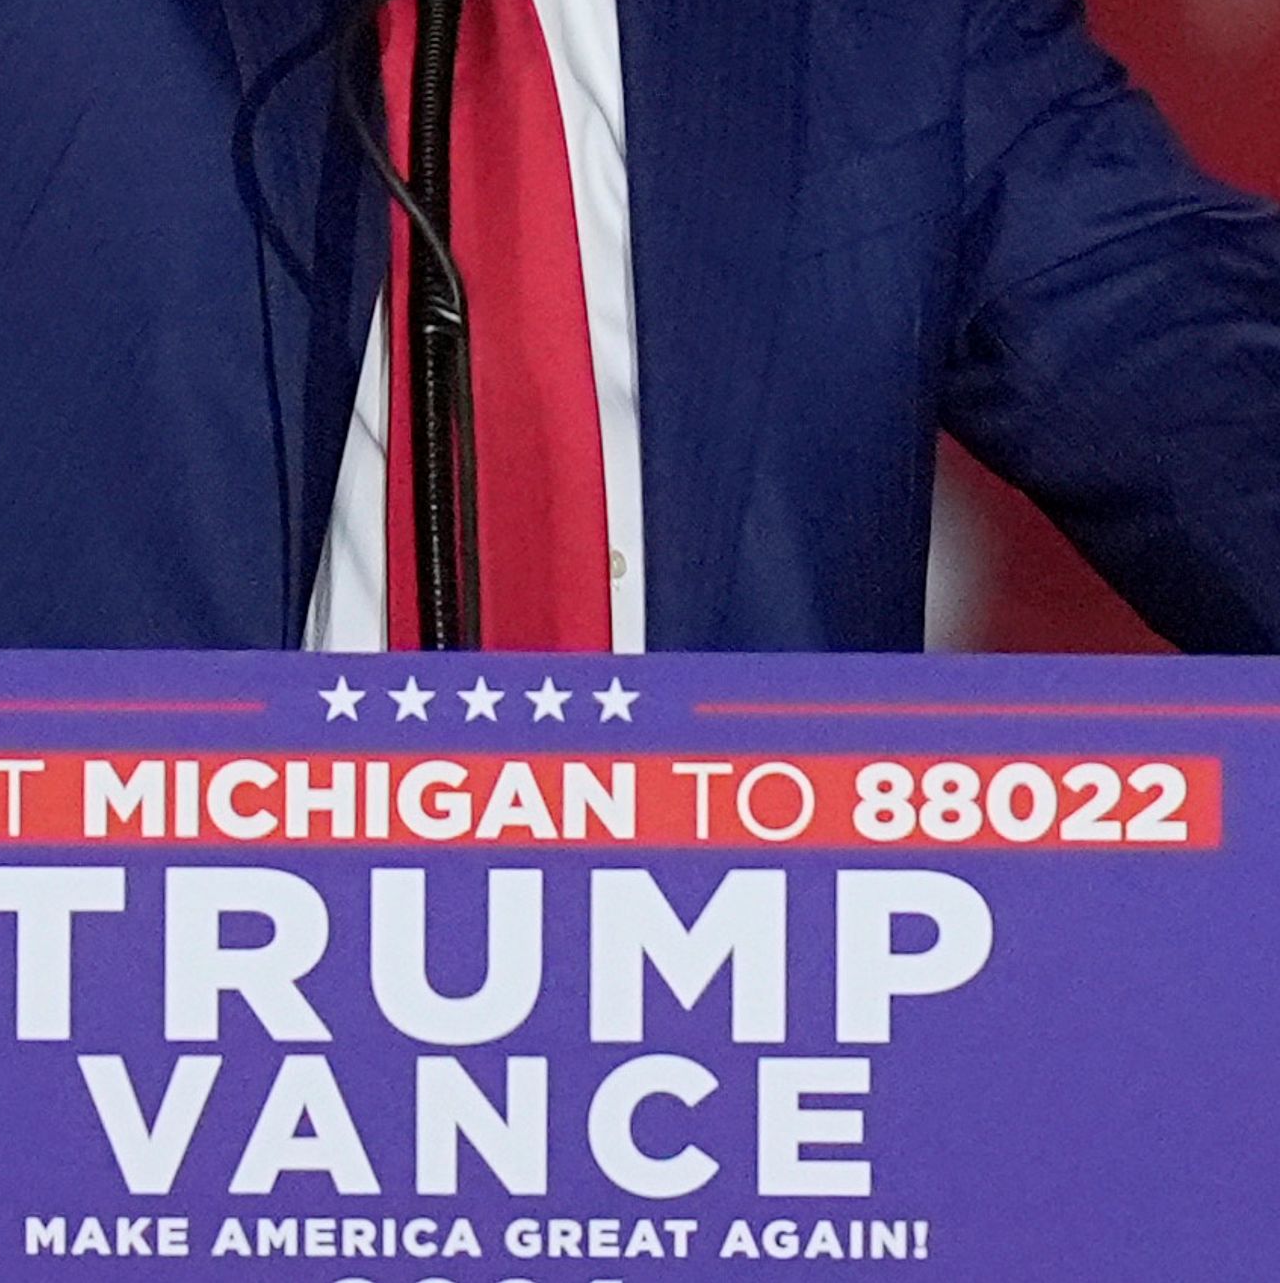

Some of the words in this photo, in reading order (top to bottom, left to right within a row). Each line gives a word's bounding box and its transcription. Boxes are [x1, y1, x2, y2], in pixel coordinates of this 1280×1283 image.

[84, 759, 637, 841] MICHIGAN
[672, 762, 816, 842] TO
[853, 762, 1188, 843] 88022
[77, 1054, 872, 1199] VANCE
[26, 1217, 190, 1256] MAKE
[212, 1218, 483, 1258] AMERICA
[505, 1218, 699, 1259] GREAT
[720, 1220, 929, 1260] AGAIN!
